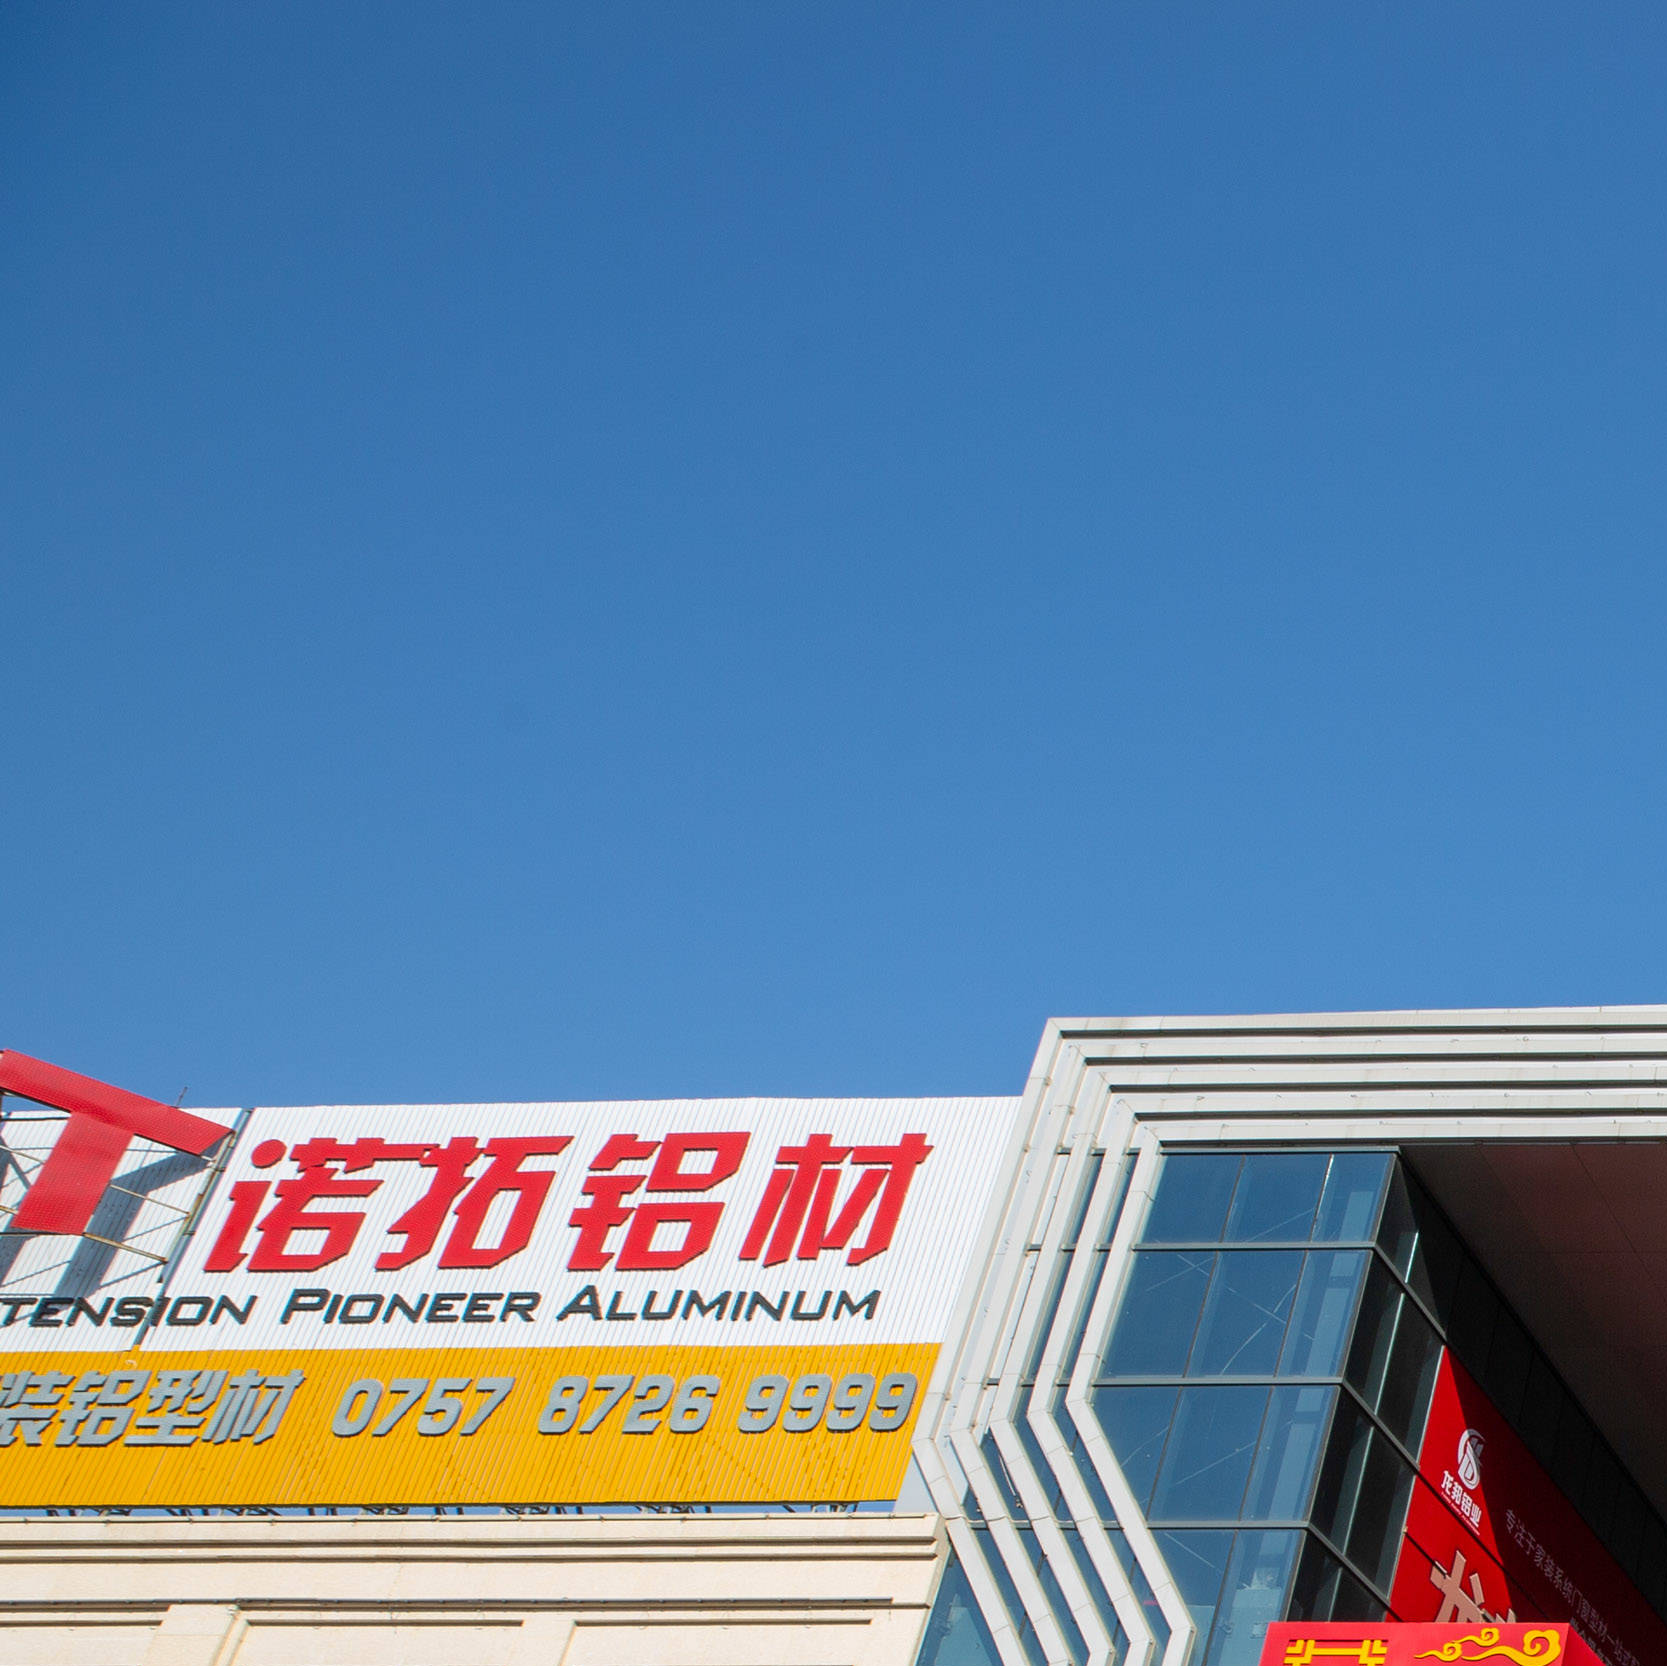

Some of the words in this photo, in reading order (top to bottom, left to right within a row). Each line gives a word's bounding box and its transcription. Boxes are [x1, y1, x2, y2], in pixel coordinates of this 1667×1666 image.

[203, 1131, 932, 1272] 诺拓铝材
[281, 1287, 541, 1325] PIONEER
[558, 1284, 882, 1322] ALUMINUM
[331, 1376, 517, 1438] 0757
[537, 1373, 723, 1436] 8726
[737, 1371, 920, 1434] 9999
[1441, 1469, 1482, 1528] 龙邦铝业
